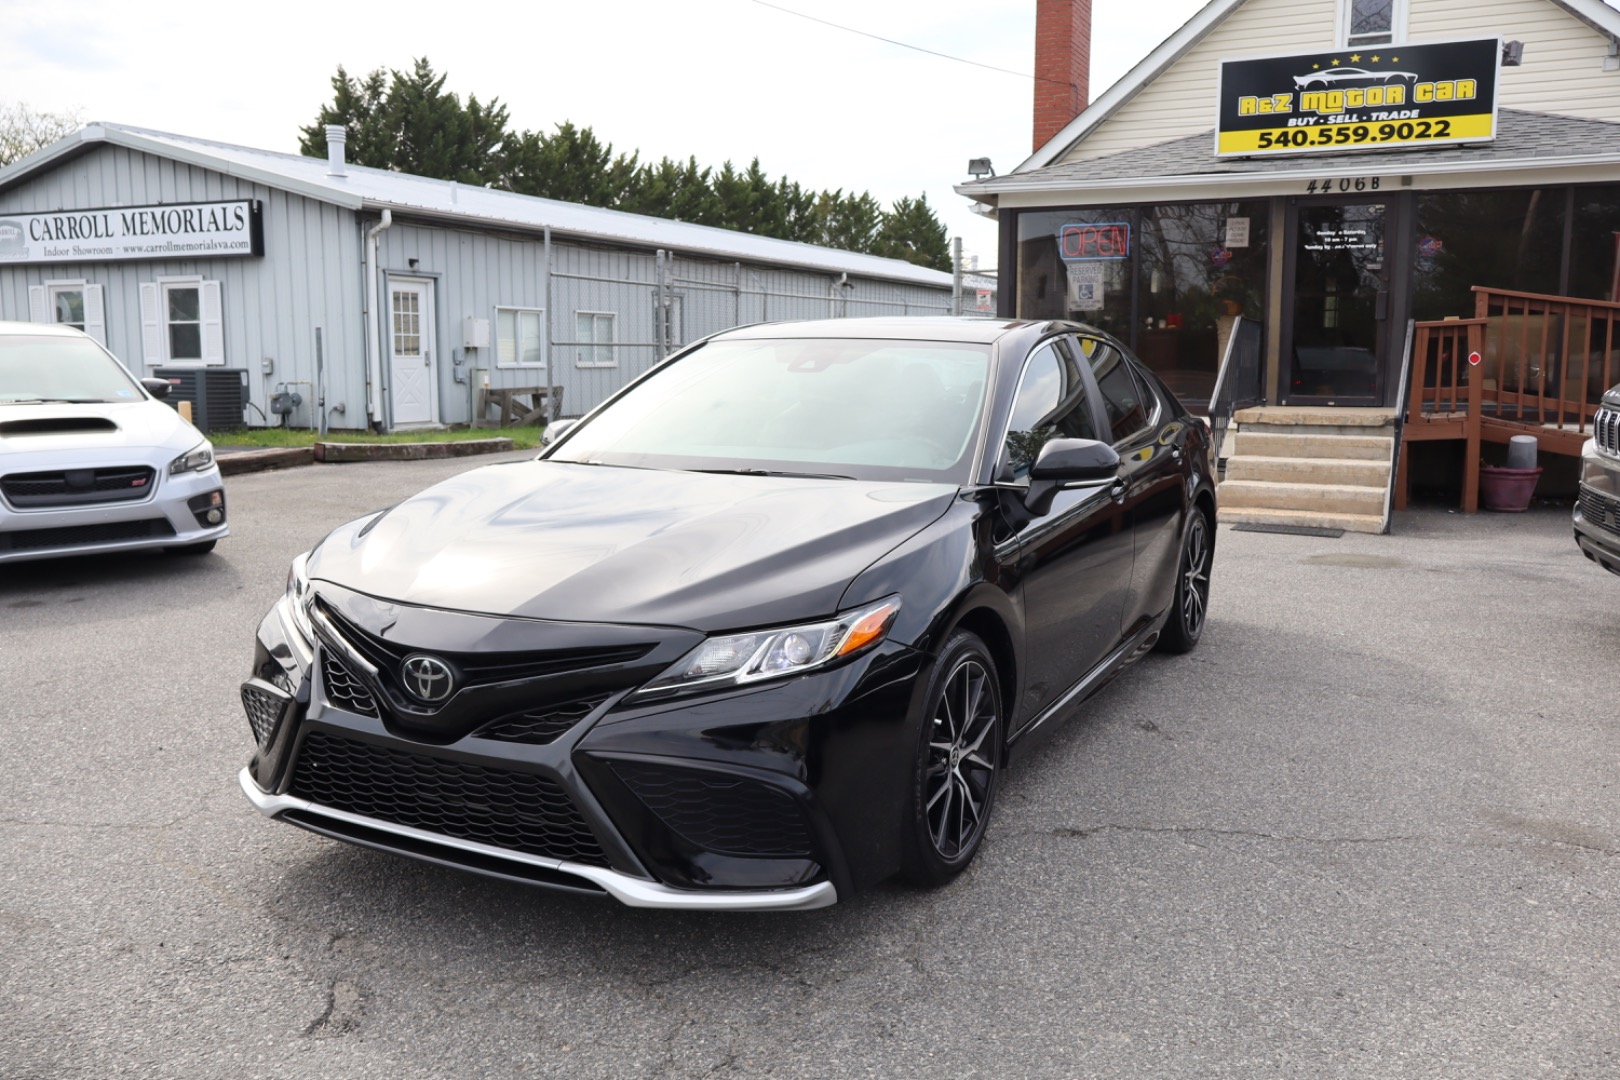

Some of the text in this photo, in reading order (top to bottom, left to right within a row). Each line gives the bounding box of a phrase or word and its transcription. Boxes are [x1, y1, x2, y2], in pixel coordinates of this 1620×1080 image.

[1238, 94, 1293, 116] R&Z
[1287, 109, 1420, 127] BUY SELL TRADE
[1258, 120, 1451, 149] 540.559.9022
[29, 206, 244, 242] CARROLL MEMORIALS
[43, 239, 250, 257] Indoor Showroom www.carrollmemorialsva.com
[1064, 226, 1127, 256] OPEN
